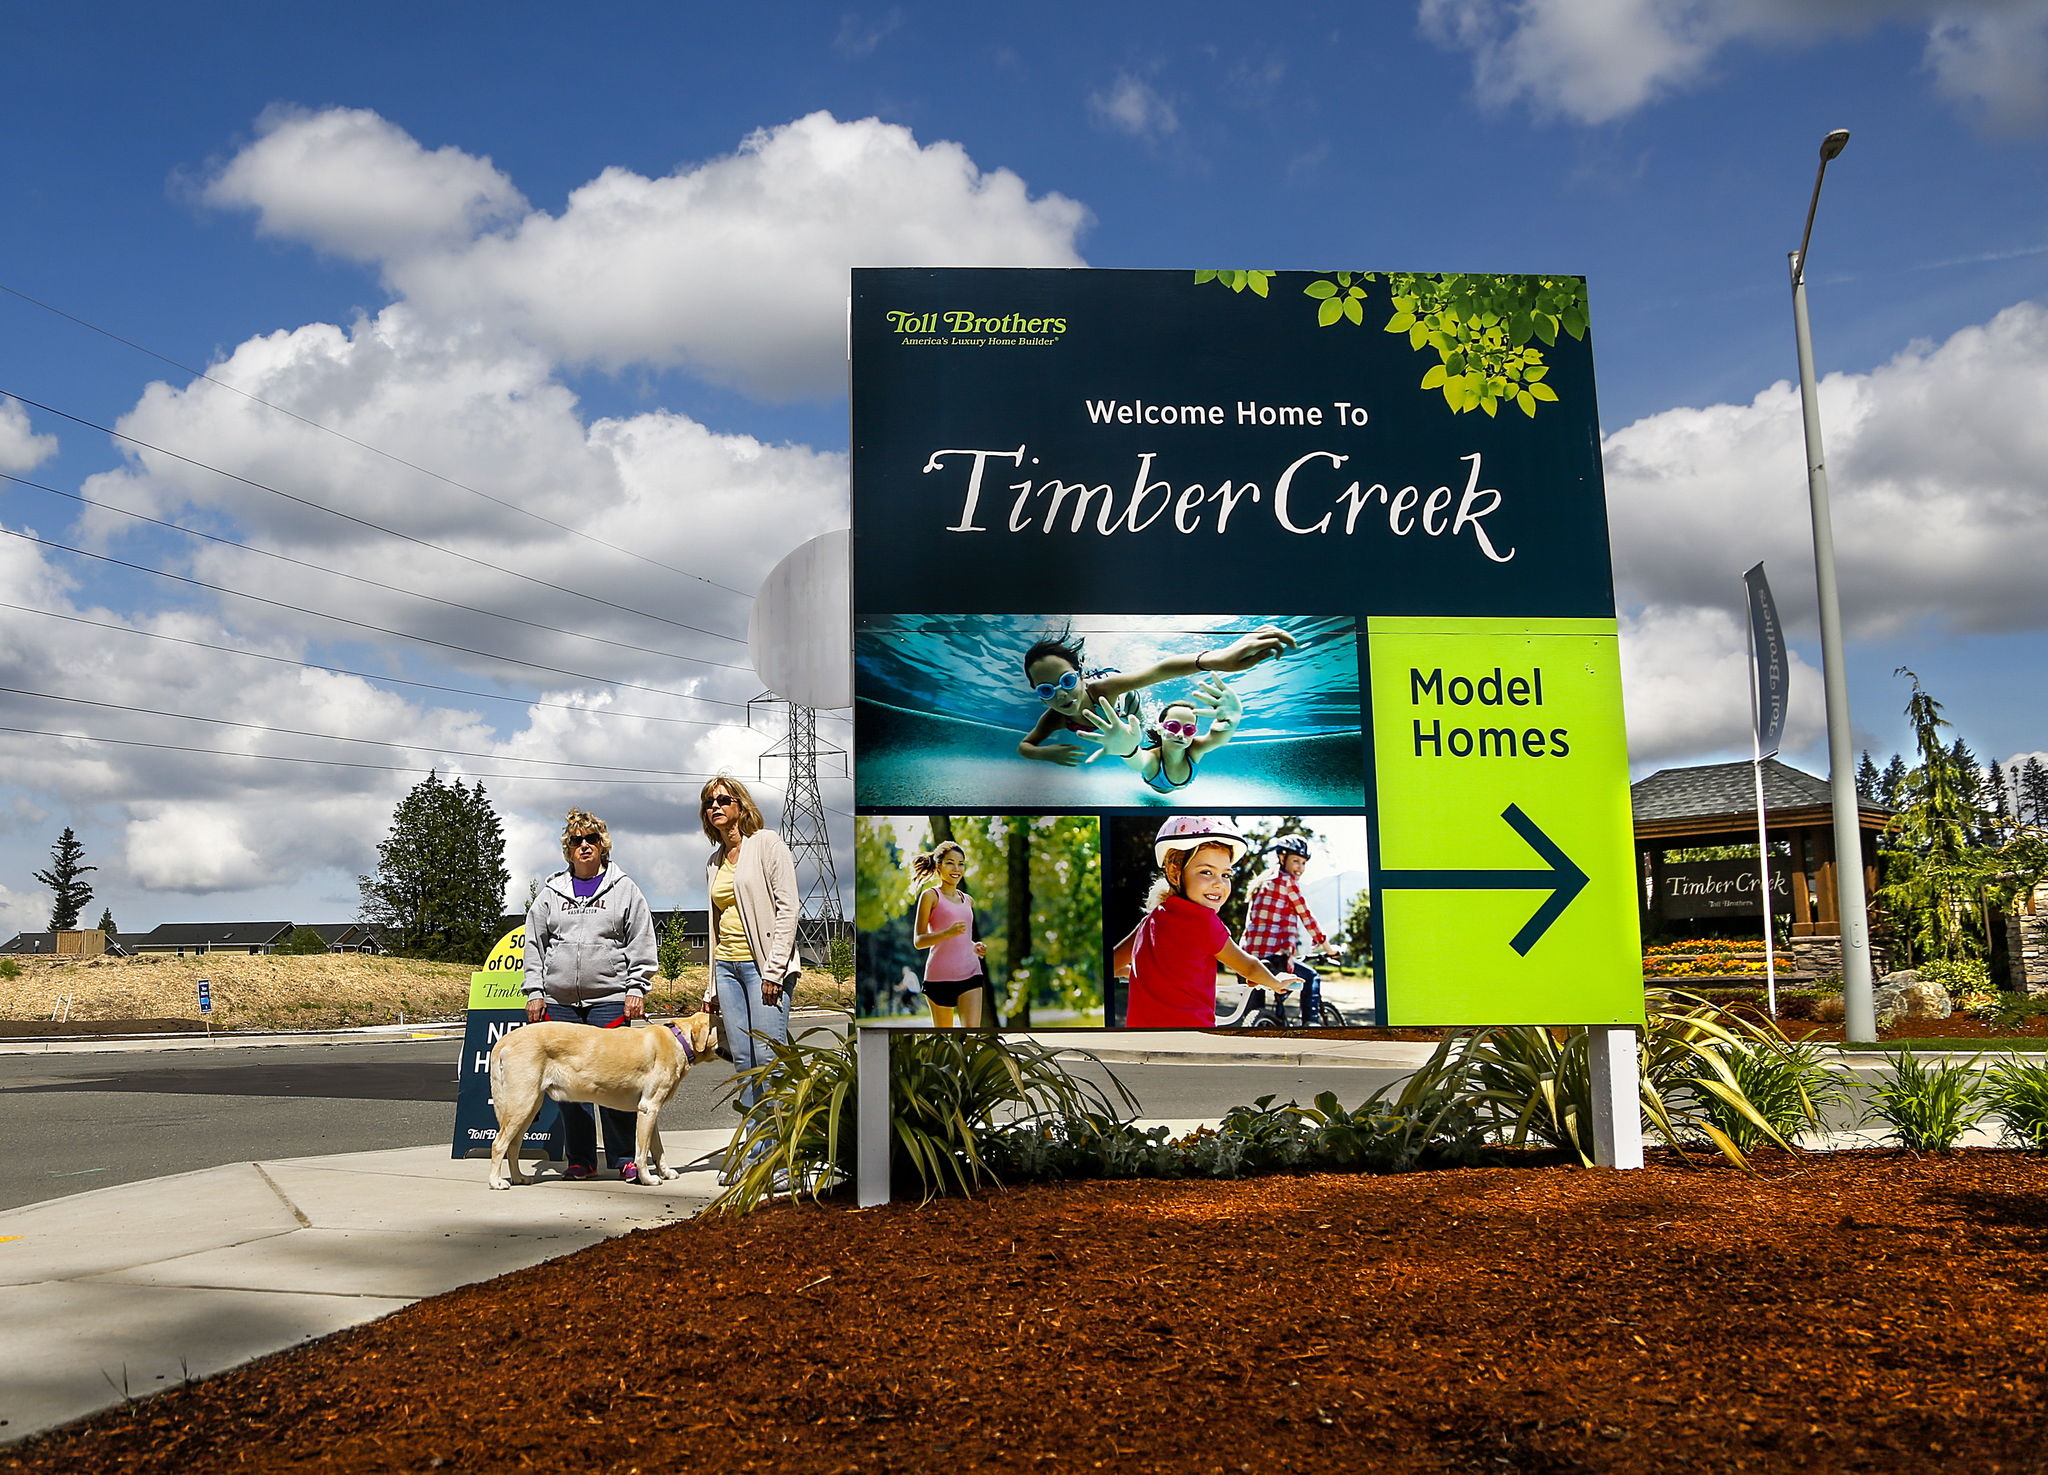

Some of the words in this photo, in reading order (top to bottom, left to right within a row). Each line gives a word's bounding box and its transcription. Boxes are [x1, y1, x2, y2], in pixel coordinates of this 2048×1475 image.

[886, 310, 938, 333] Toll
[943, 311, 1067, 333] Brothers
[901, 337, 949, 346] America's
[951, 337, 988, 347] Luxury
[988, 337, 1016, 346] Home
[1086, 400, 1225, 425] Welcome
[1236, 401, 1323, 426] Home
[1334, 402, 1369, 427] To
[923, 444, 1260, 536] Timber
[1274, 451, 1515, 563] Creek
[1758, 588, 1781, 690] Brothers
[1410, 667, 1543, 706] Model
[1768, 695, 1781, 737] Toll
[1413, 719, 1570, 758] Homes
[1665, 875, 1734, 896] Timber
[1735, 870, 1789, 895] Crek
[488, 955, 503, 970] of
[483, 983, 524, 998] Timbe
